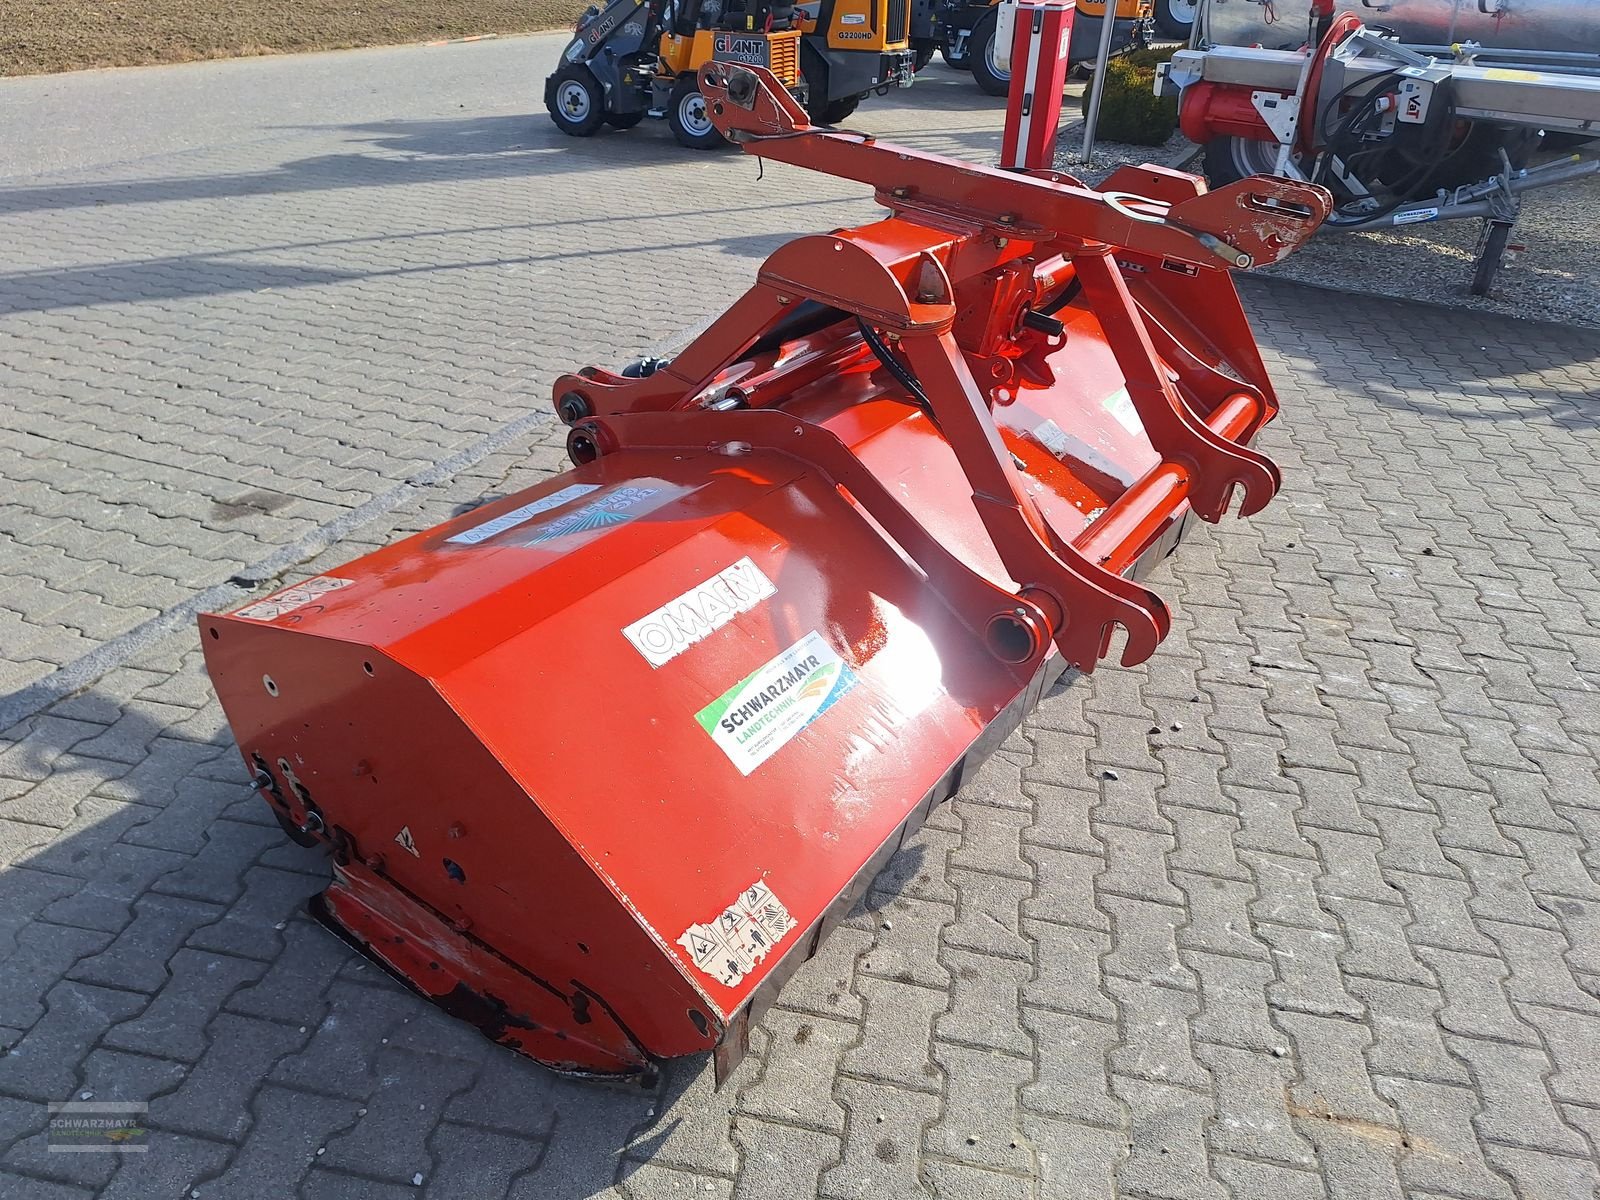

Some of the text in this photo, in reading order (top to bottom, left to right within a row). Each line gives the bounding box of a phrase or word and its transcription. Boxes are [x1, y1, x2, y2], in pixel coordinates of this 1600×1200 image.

[838, 31, 872, 39] G2200HD
[738, 54, 763, 64] G1200
[721, 654, 821, 734] SCHWARZMAYR
[736, 695, 796, 745] LANDTECHNIK
